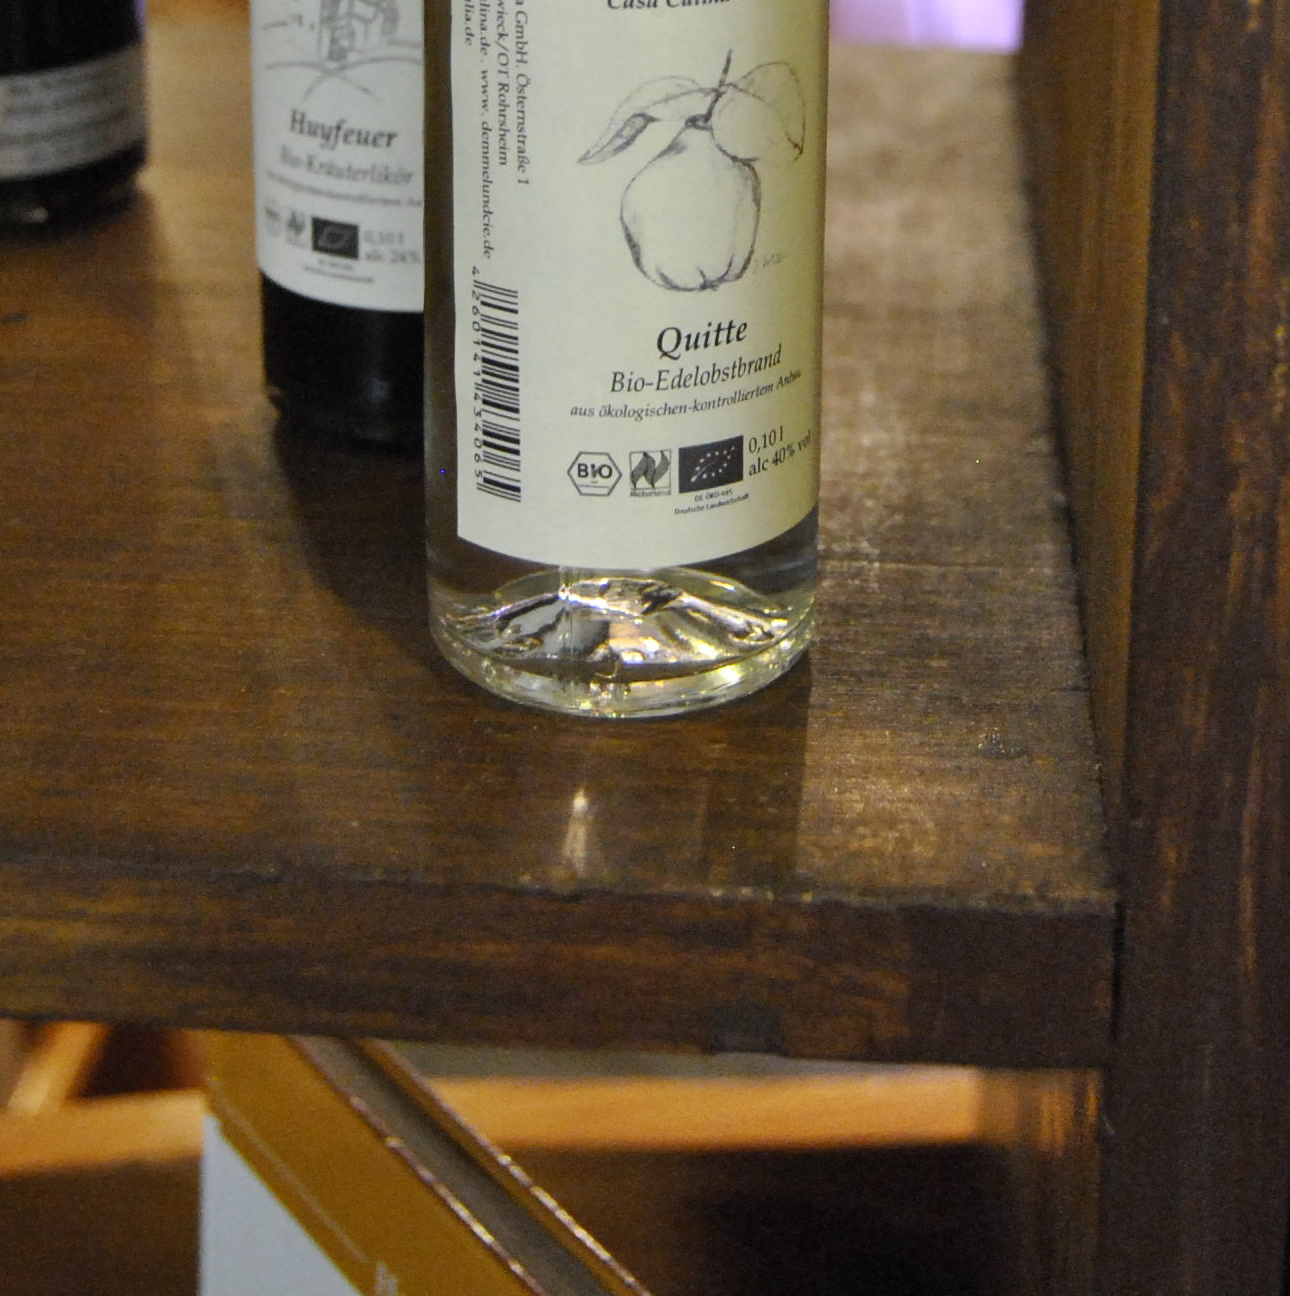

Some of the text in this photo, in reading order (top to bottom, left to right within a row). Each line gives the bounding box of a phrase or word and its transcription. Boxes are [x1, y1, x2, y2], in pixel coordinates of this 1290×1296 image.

[497, 82, 510, 166] Rohrsheim
[656, 318, 749, 360] Quitte
[610, 343, 783, 393] Bio-Edelobstbrand
[570, 405, 596, 417] aus
[599, 383, 774, 422] ökologischen-kontrolliertem
[748, 429, 776, 455] 0,10
[748, 456, 769, 476] alc
[772, 443, 795, 466] 40%
[577, 463, 613, 479] BIO
